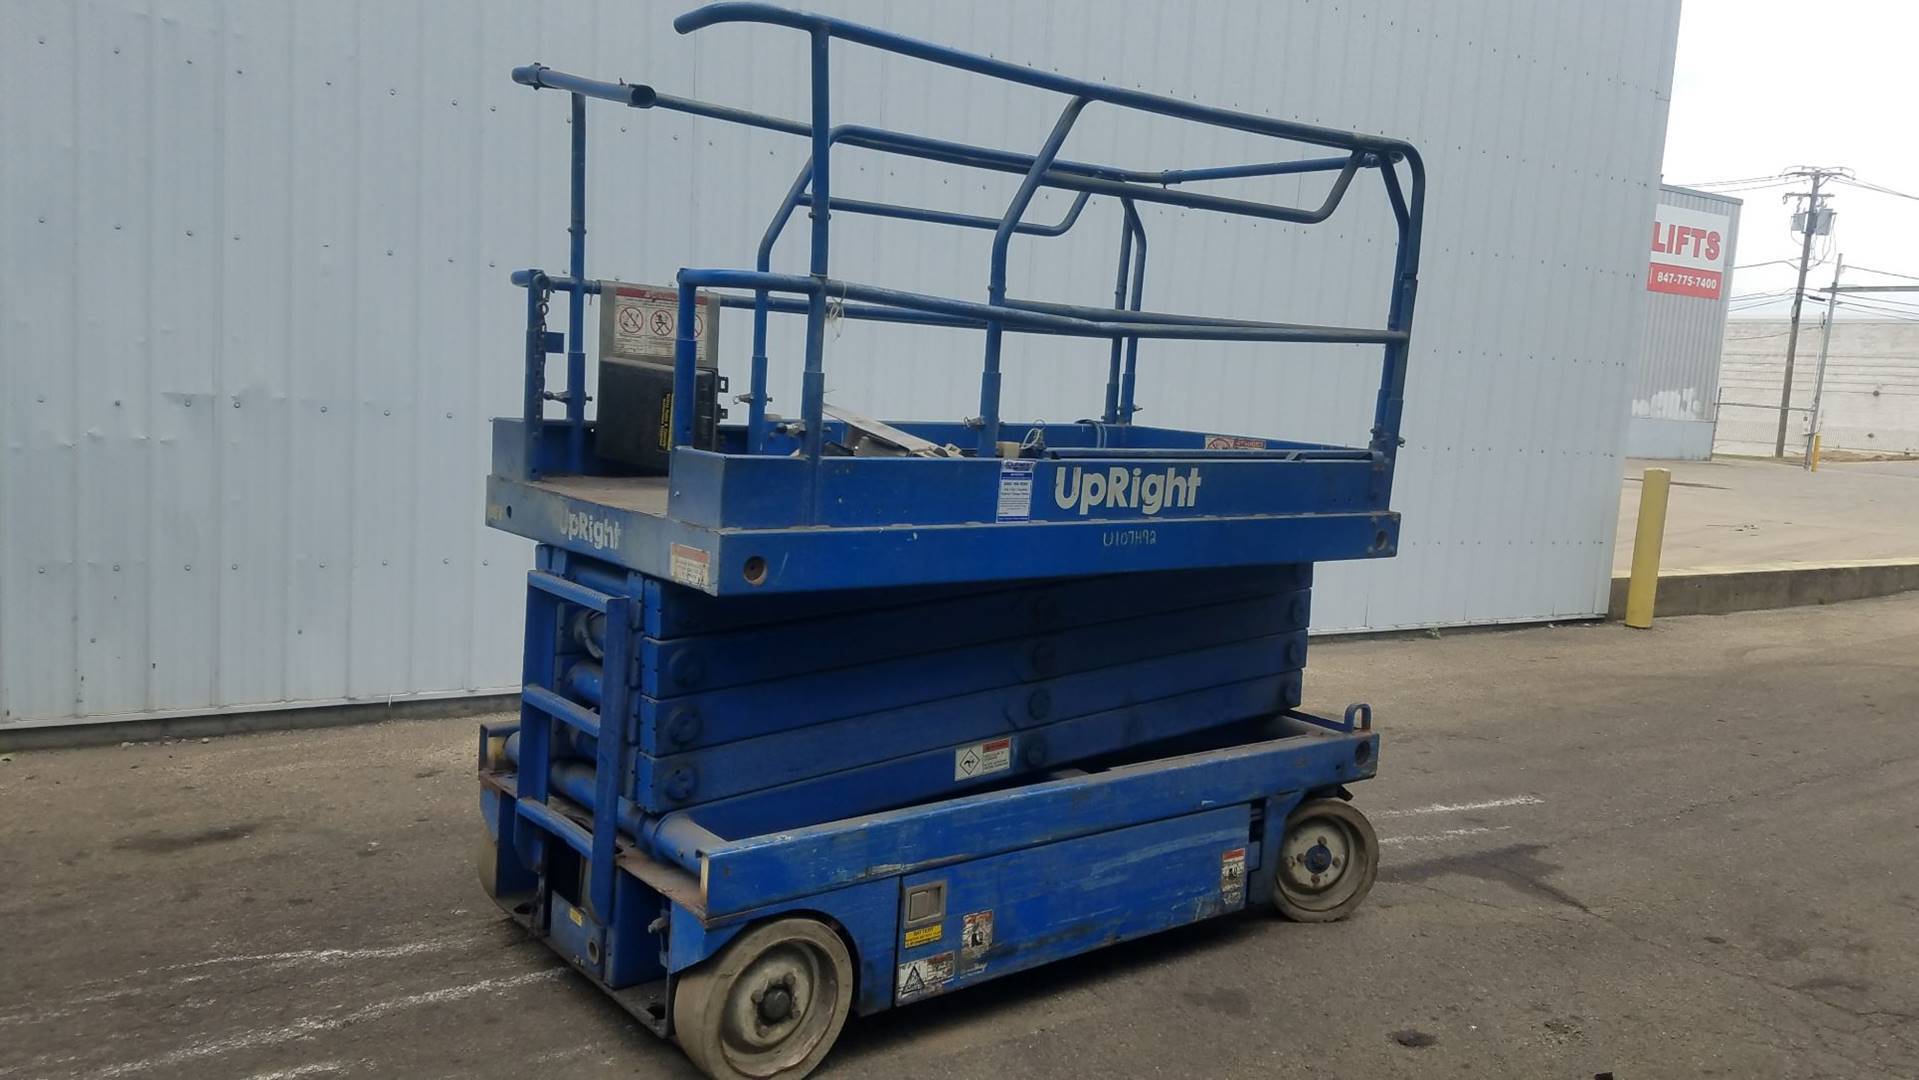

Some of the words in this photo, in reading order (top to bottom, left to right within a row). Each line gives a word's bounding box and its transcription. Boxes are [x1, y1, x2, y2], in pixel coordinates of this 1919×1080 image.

[1652, 222, 1721, 260] LIFTS
[1657, 271, 1717, 289] 847-775-7400
[1055, 466, 1202, 515] UpRight
[560, 506, 621, 550] UpRight
